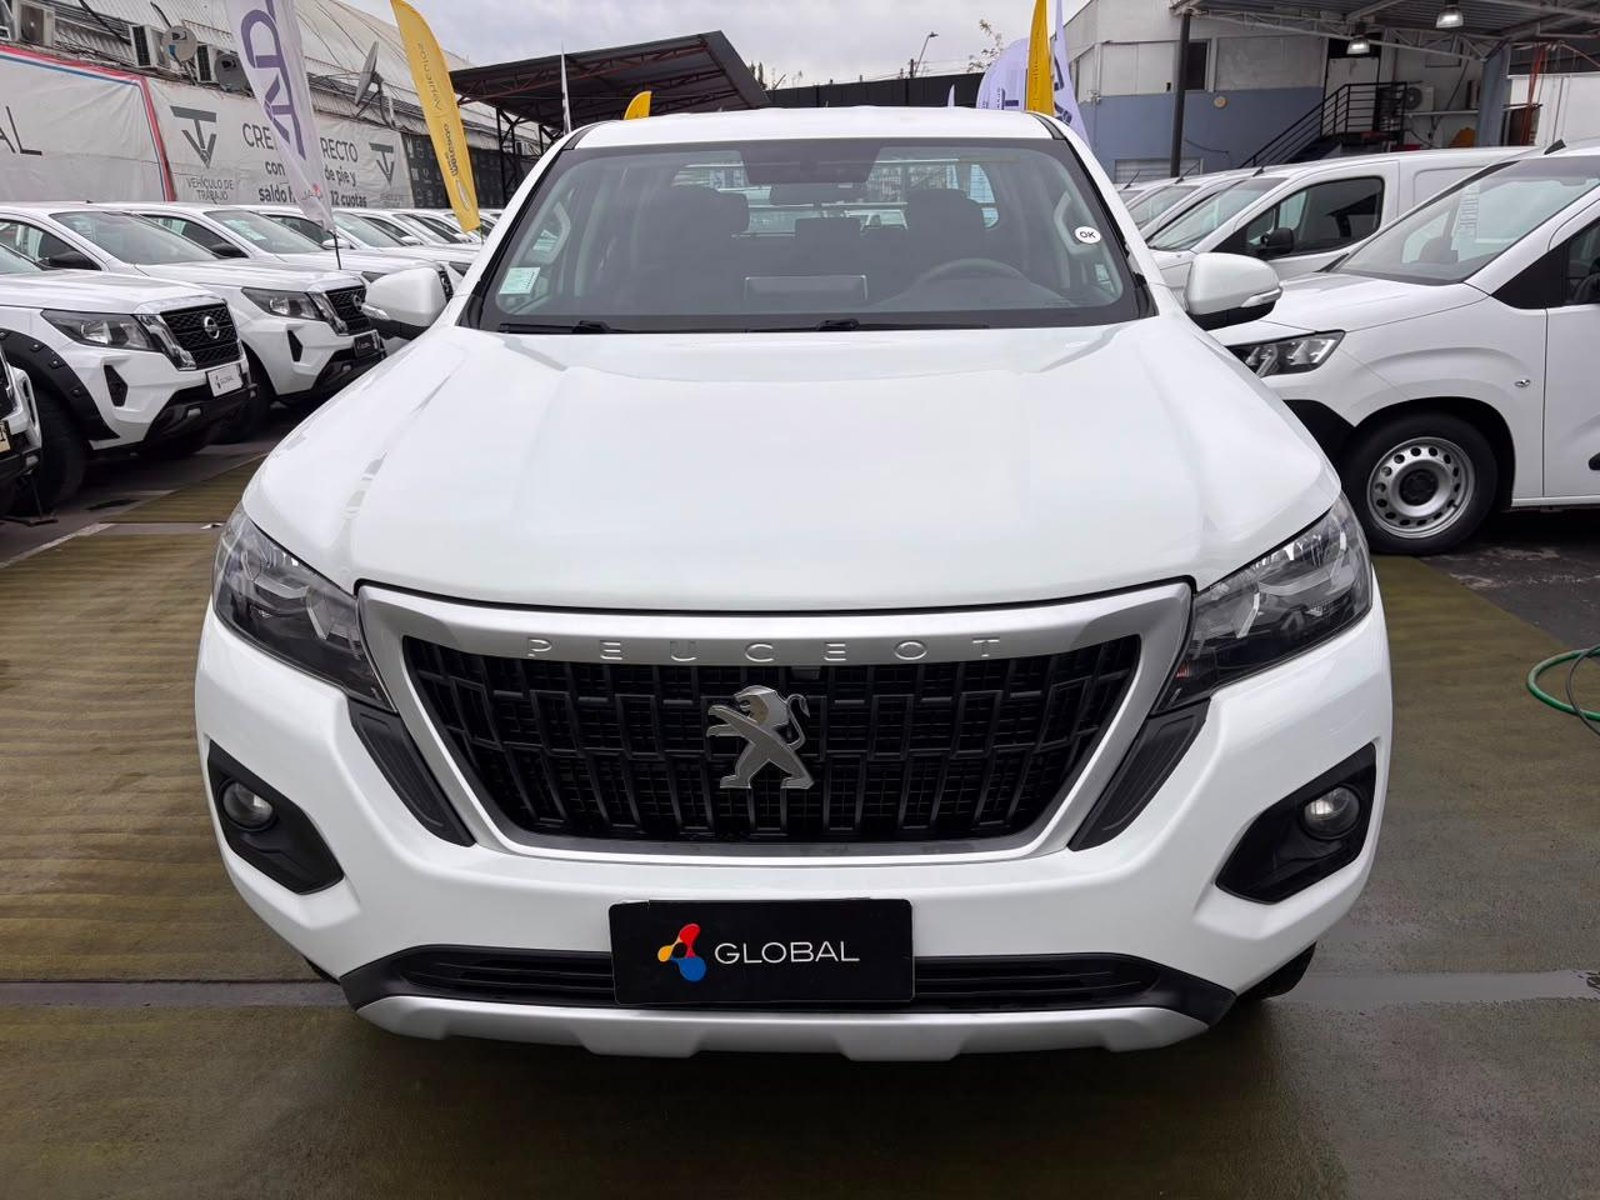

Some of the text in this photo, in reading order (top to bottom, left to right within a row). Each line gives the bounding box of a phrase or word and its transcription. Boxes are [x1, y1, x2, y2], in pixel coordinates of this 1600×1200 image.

[242, 123, 358, 163] CRE RECTO
[265, 161, 286, 176] con
[324, 163, 336, 181] de
[258, 184, 287, 203] saldo
[330, 190, 339, 206] 12
[341, 193, 367, 208] cuotas
[1079, 230, 1096, 239] OK
[714, 940, 861, 964] GLOBAL
